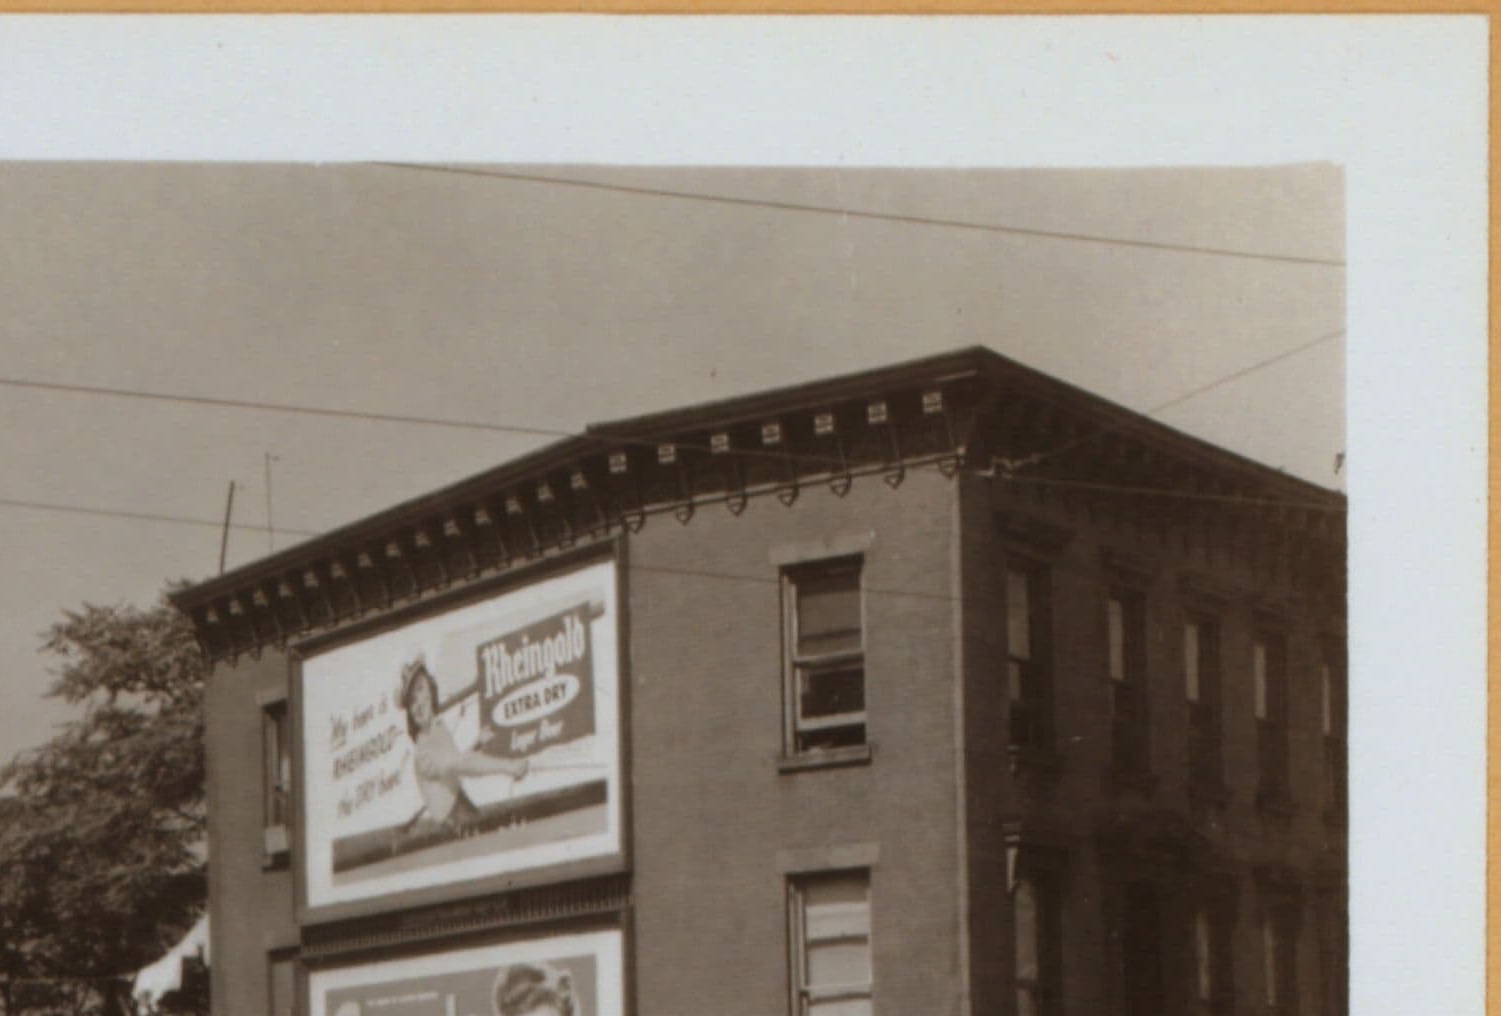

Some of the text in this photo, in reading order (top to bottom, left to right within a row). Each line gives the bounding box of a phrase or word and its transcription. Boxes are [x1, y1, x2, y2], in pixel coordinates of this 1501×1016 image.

[482, 615, 585, 699] Rheingold
[504, 682, 568, 720] EXTRA DRY
